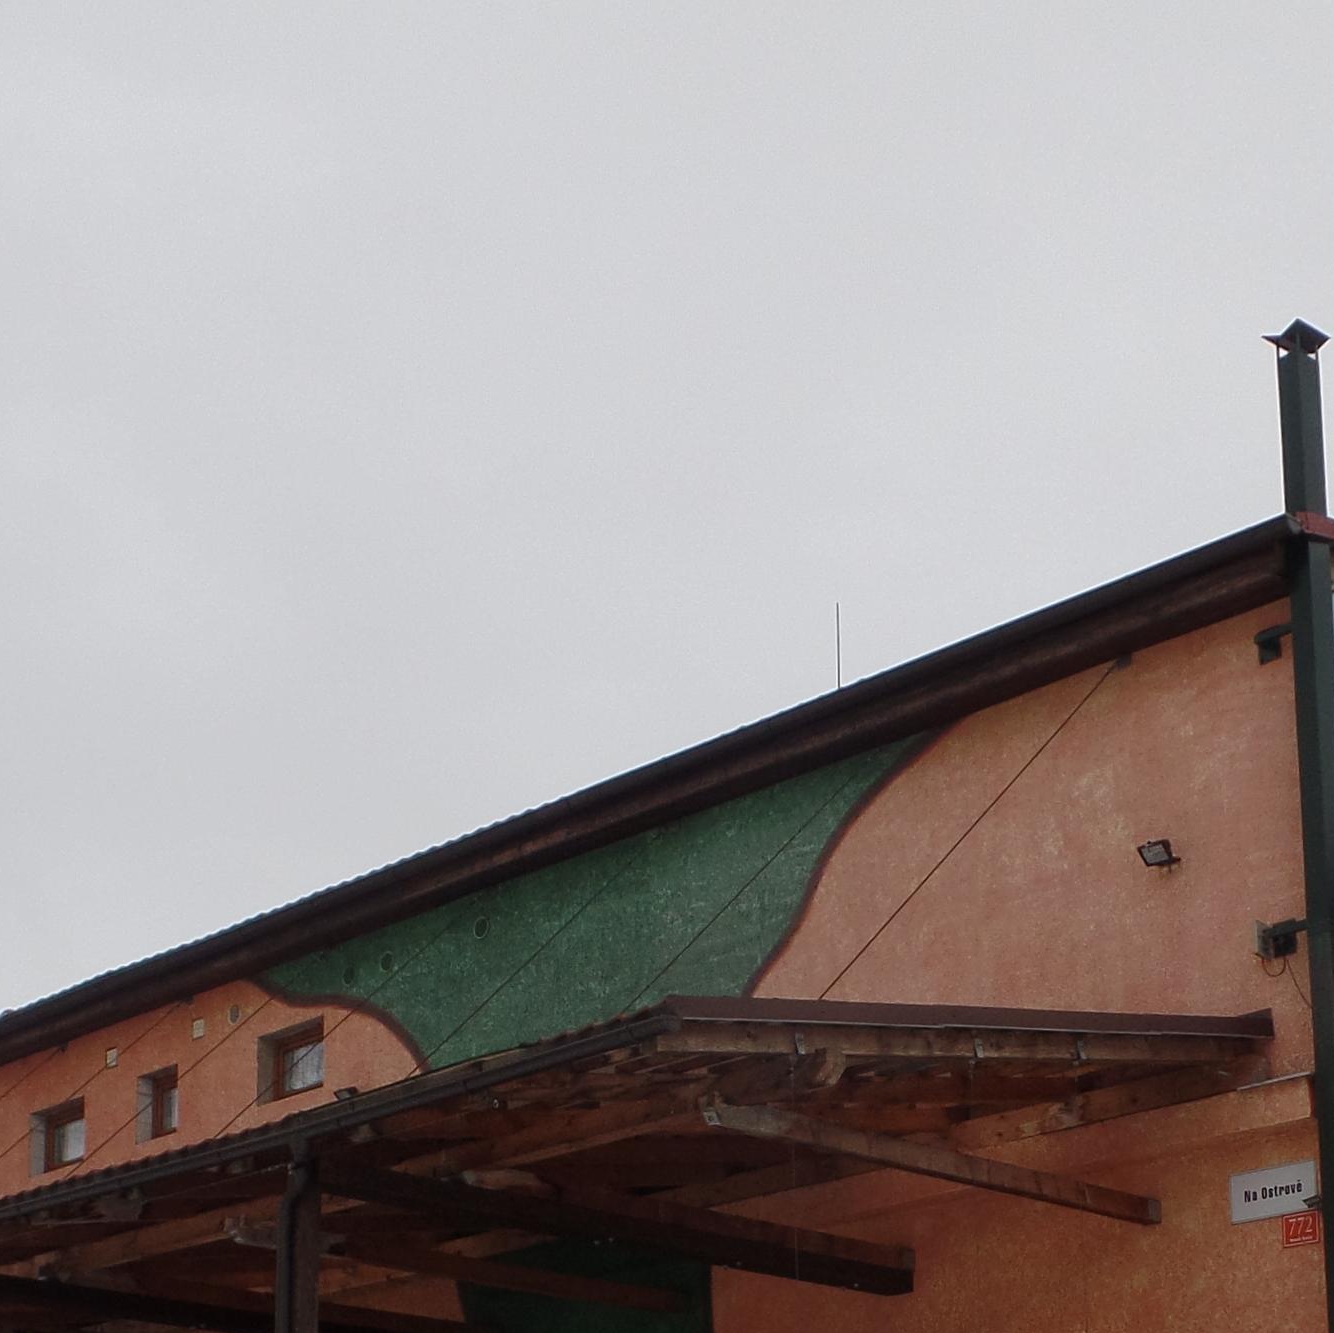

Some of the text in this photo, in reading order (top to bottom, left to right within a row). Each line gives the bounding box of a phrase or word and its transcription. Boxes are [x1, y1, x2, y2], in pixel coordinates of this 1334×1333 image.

[1244, 1179, 1303, 1203] Na Ostrově
[1289, 1215, 1313, 1236] 772
